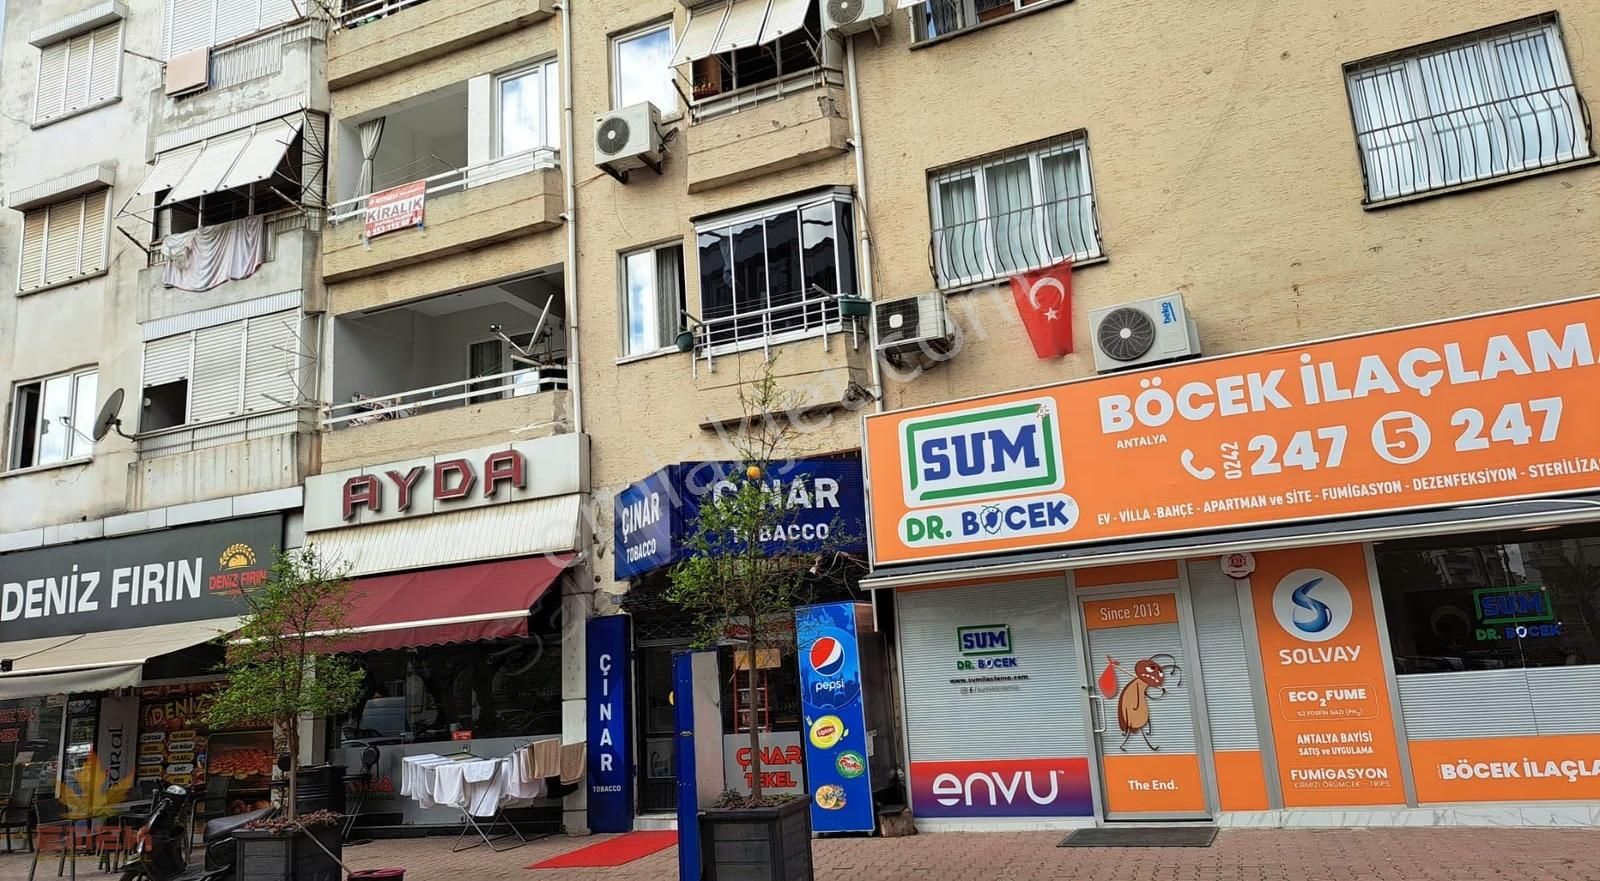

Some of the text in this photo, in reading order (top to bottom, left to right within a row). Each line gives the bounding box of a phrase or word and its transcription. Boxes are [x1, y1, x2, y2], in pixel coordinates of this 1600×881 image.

[1098, 322, 1600, 434] BÖCEK İLAÇLAM
[1116, 433, 1168, 449] ANTALYA
[1220, 396, 1563, 480] 0242 247 5 247
[921, 423, 1040, 482] SUM
[342, 449, 527, 521] AYDA
[1097, 513, 1111, 526] EV
[1119, 509, 1150, 523] VİLLA
[1203, 495, 1267, 513] APARTMAN
[1269, 496, 1284, 506] ve
[1286, 488, 1313, 504] SİTE
[1321, 480, 1402, 501] FUMİGASYON
[1413, 467, 1517, 491] DEZENFEKSİYON
[1528, 456, 1600, 478] STERİLİZA
[622, 492, 660, 544] ÇINAR
[906, 515, 953, 542] DR.
[730, 523, 830, 543] TBACCO
[626, 538, 656, 565] TOBACCO
[1, 557, 203, 622] DENİZ FIRIN
[1100, 602, 1161, 621] Since 2013
[1481, 593, 1545, 616] SUM
[963, 630, 1007, 650] SUM
[957, 660, 975, 670] DR.
[1279, 645, 1361, 665] SOLVAY
[815, 678, 845, 693] pepsi
[599, 653, 613, 772] ÇINAR
[1297, 733, 1339, 744] ANTALYA
[1331, 746, 1374, 755] UYGULAMA
[1440, 758, 1521, 780] BÖCEK
[592, 784, 622, 793] TOBACCO
[1128, 779, 1179, 791] The End.
